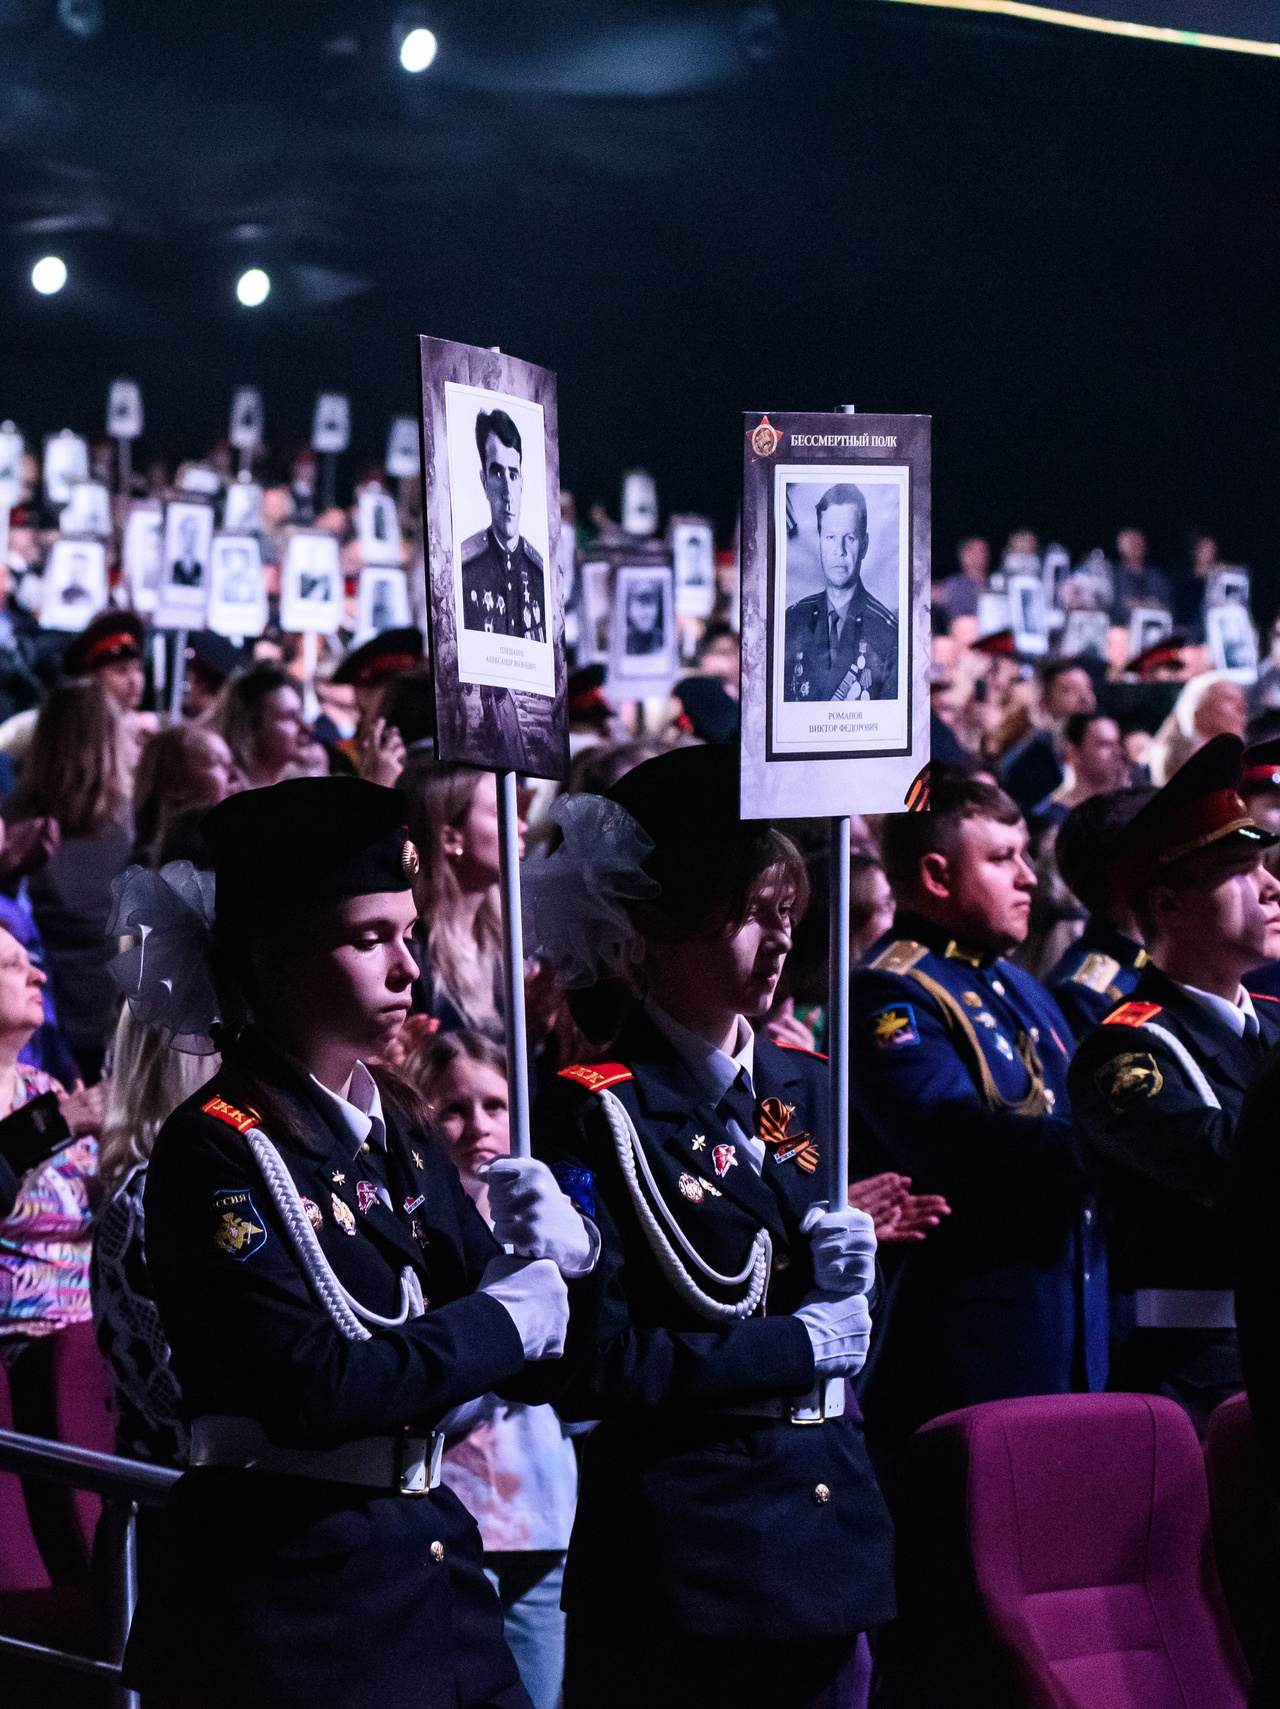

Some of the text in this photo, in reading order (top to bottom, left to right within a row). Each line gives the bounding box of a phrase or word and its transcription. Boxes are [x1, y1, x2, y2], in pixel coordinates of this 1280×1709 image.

[791, 433, 898, 447] БЕССМЕРТНЫЙ ПОЛК
[828, 711, 863, 721] РОМАНОВ
[809, 723, 879, 733] ВИКТОР ФЕДОРОВИЧ
